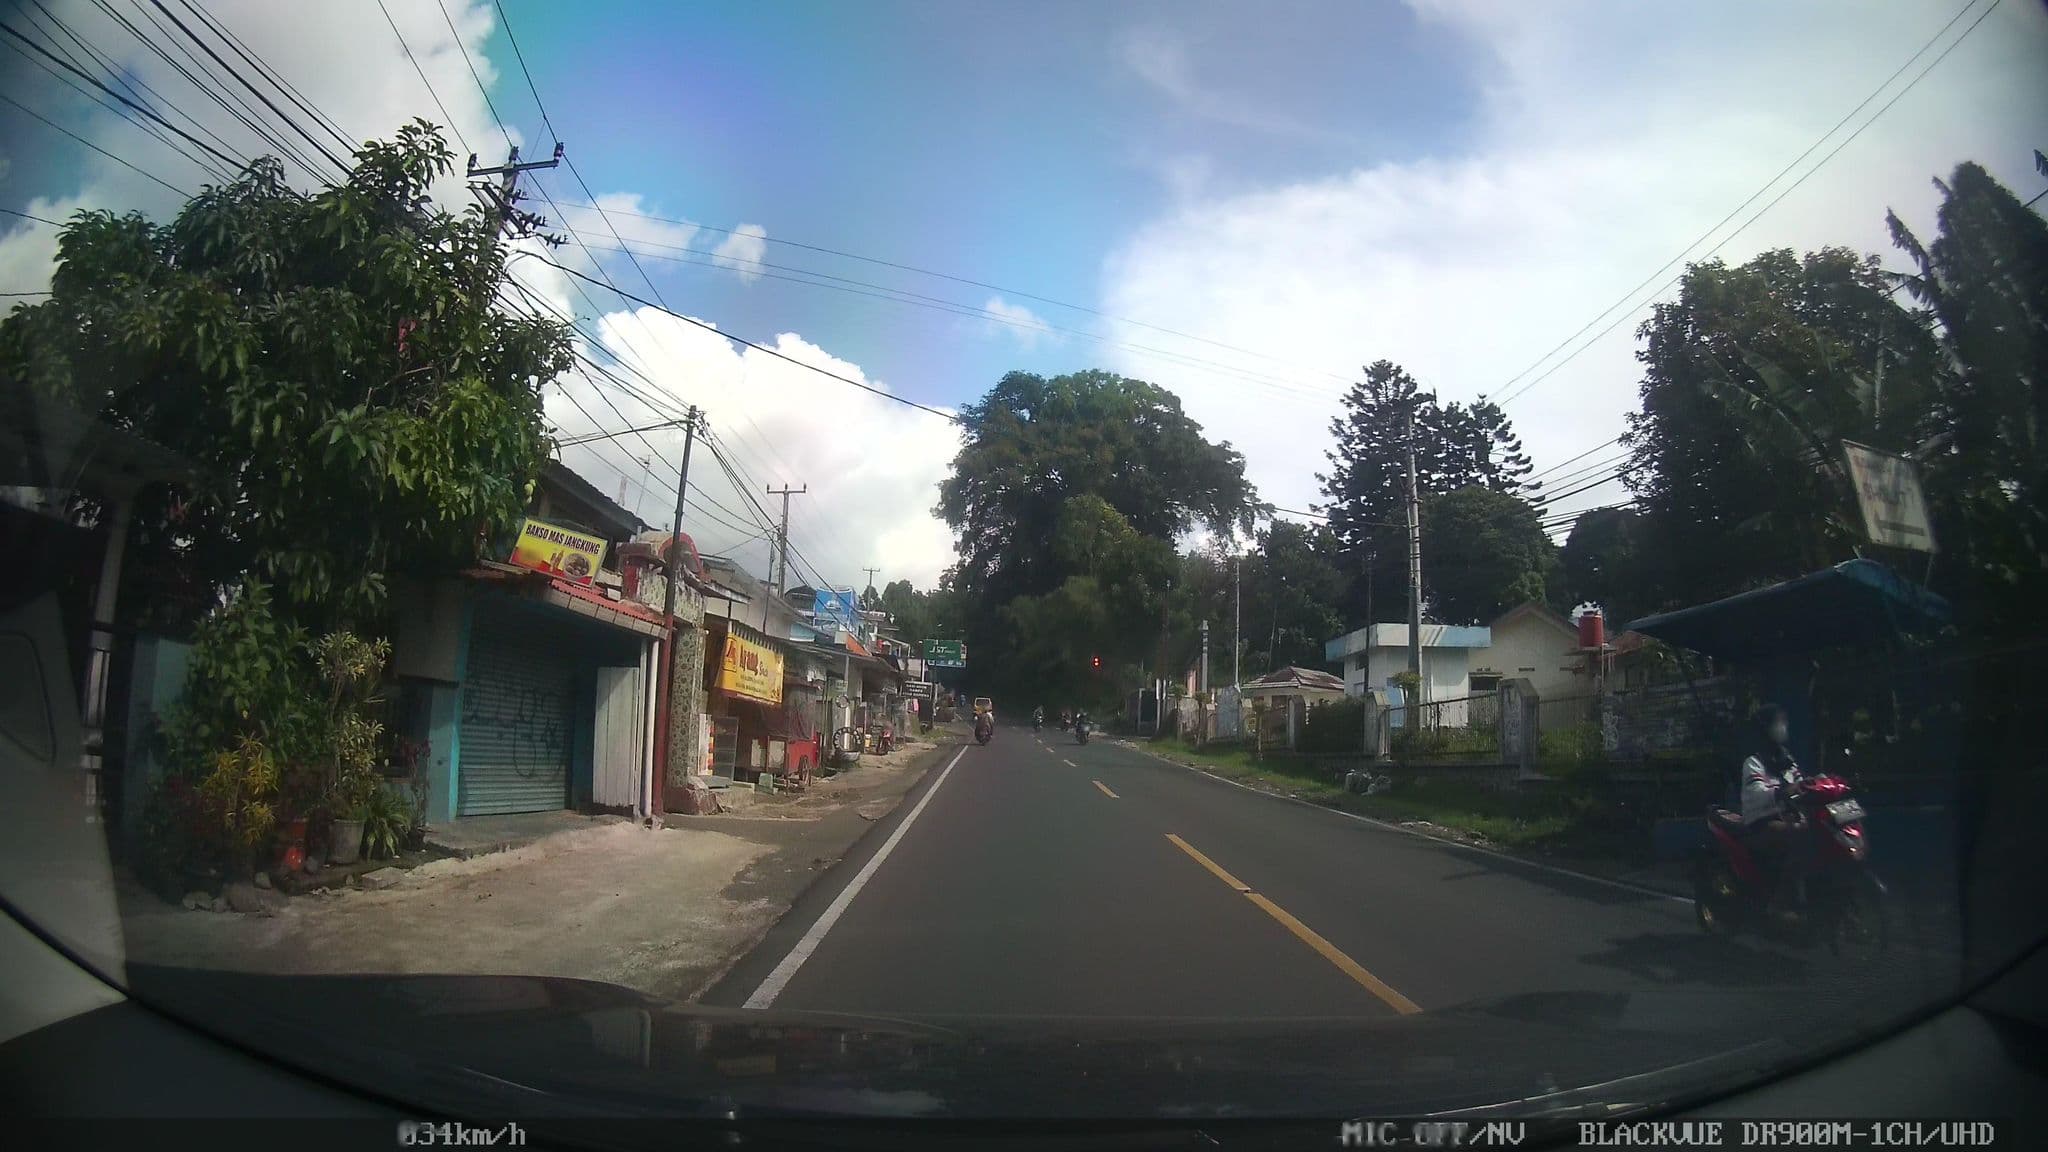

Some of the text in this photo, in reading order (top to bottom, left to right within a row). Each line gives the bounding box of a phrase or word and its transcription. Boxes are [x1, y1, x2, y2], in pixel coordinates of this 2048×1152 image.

[525, 524, 600, 554] BAKSO MAS JANGKUNG
